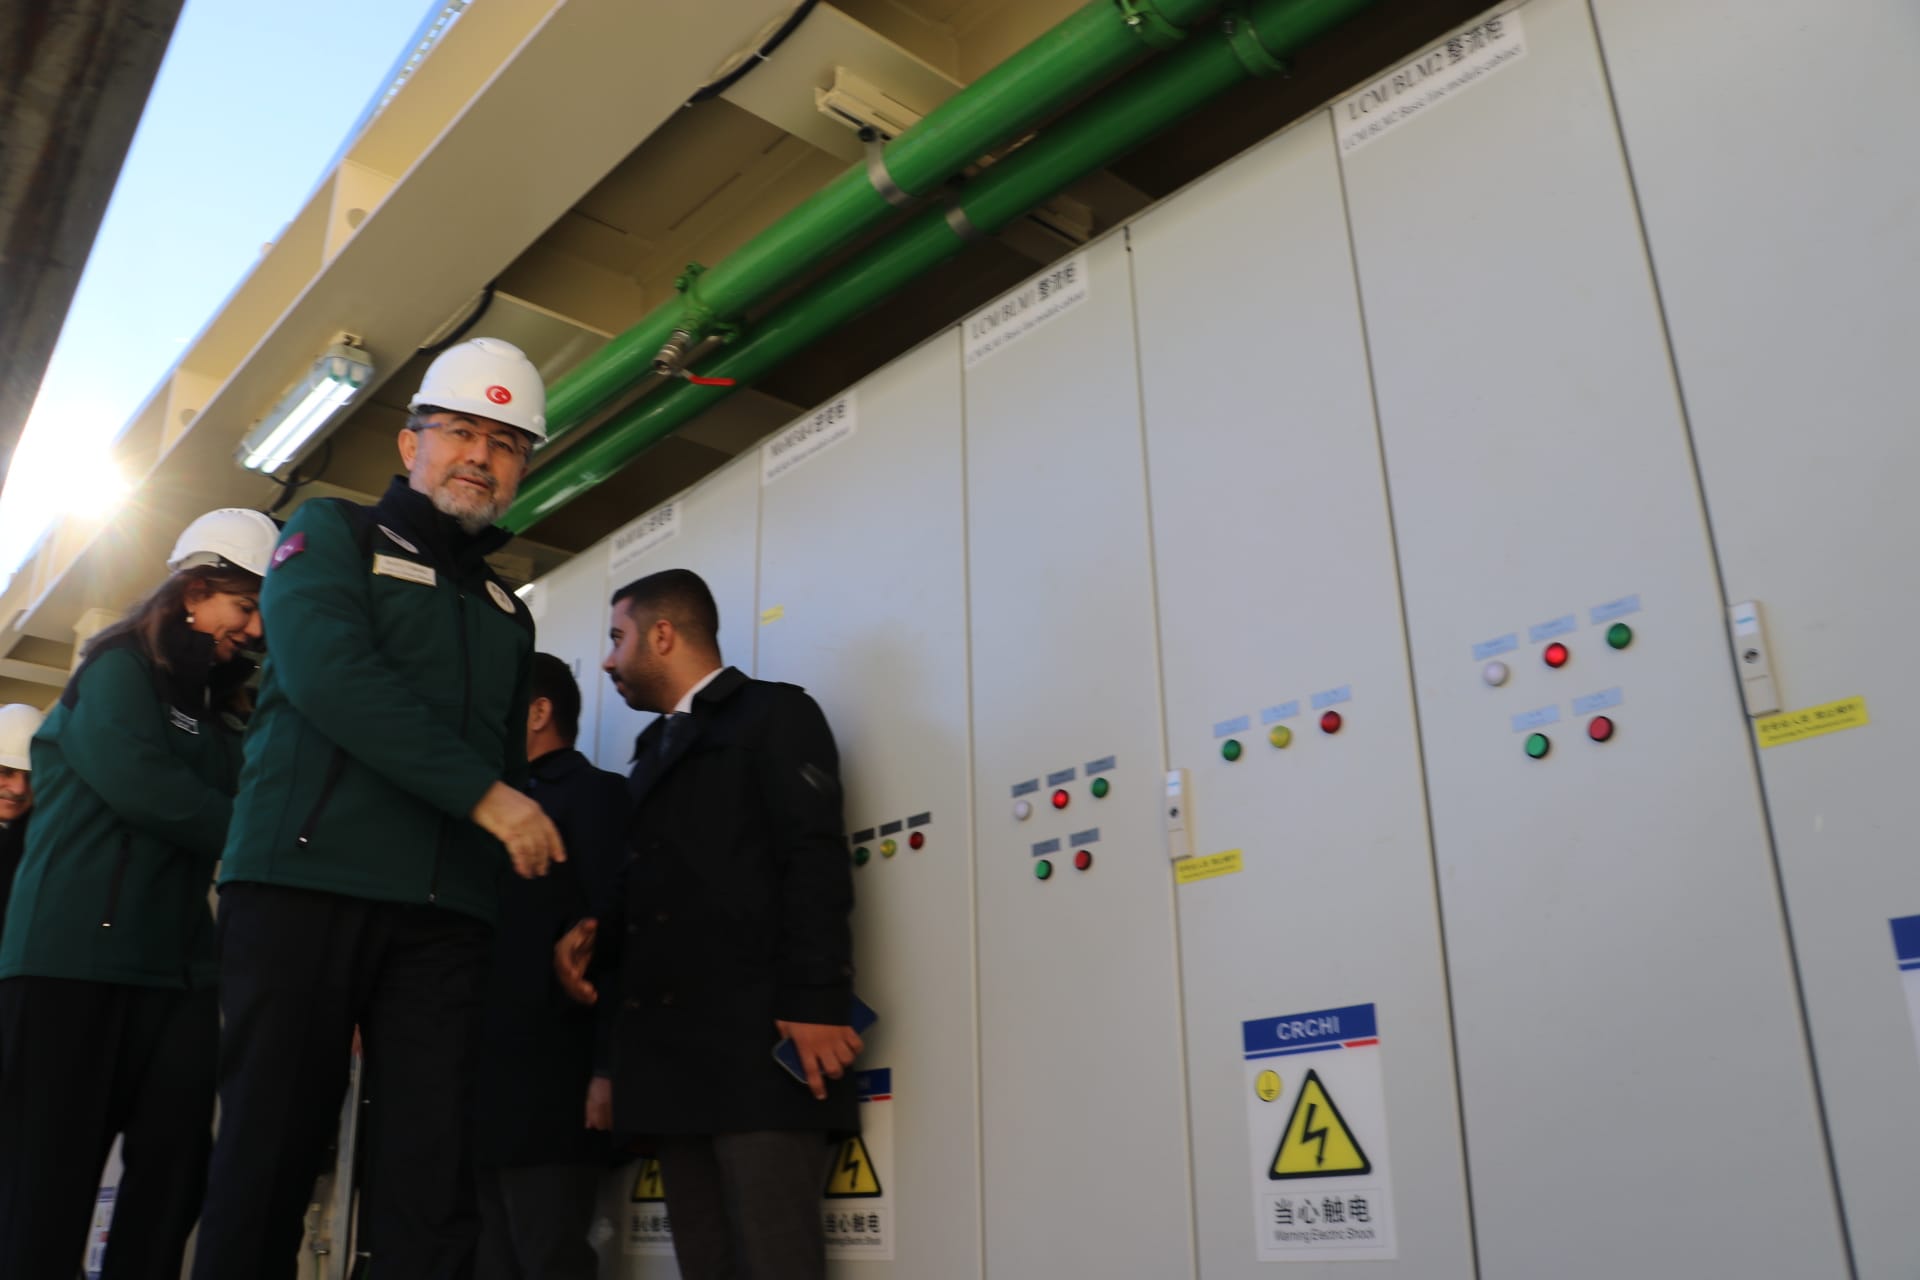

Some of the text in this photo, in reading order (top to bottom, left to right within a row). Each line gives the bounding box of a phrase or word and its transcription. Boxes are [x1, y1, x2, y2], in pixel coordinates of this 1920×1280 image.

[1276, 1015, 1342, 1040] CRCHI
[1274, 1194, 1372, 1224] 当心触电
